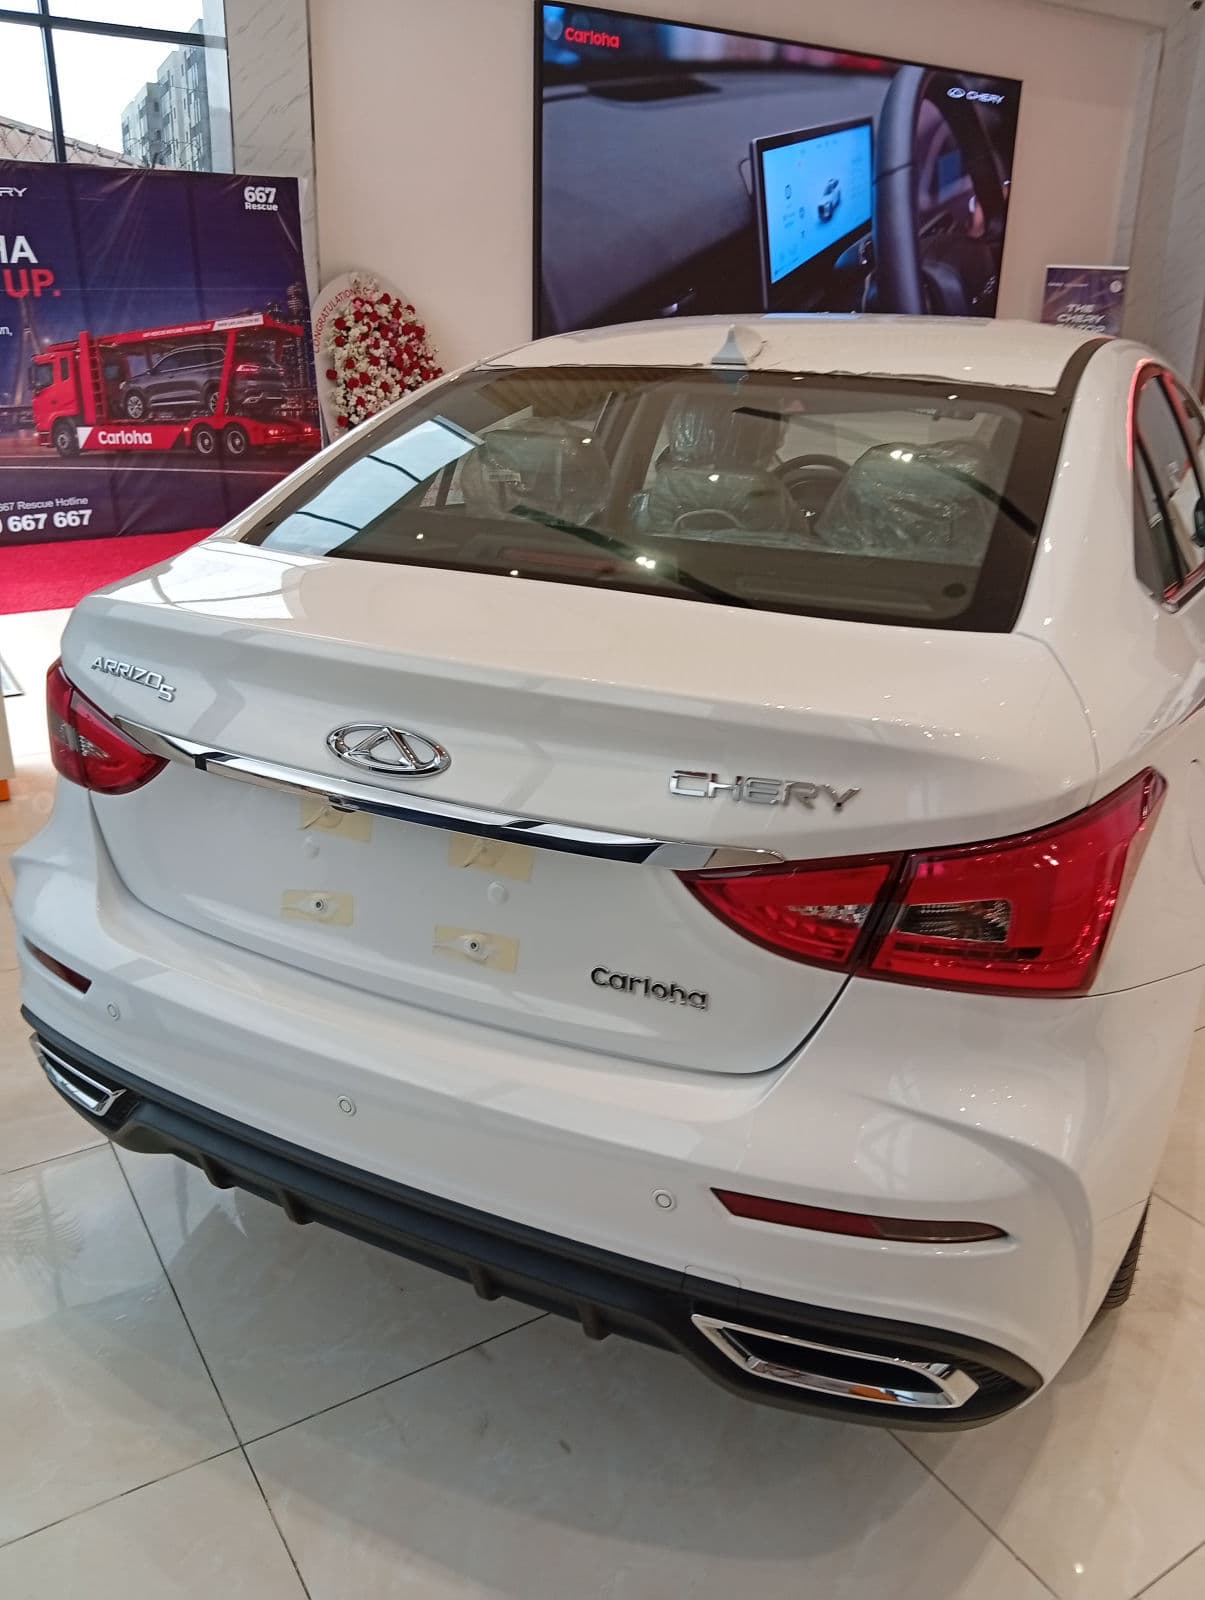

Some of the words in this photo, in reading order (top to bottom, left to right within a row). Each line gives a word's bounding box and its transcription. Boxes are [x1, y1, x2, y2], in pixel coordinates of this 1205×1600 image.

[564, 26, 621, 48] Carloha
[243, 186, 276, 203] 667
[244, 202, 278, 211] Rescue
[3, 268, 62, 298] UP.
[97, 428, 153, 446] Carloha
[17, 500, 54, 510] Rescue
[55, 497, 89, 507] Hotline
[7, 513, 48, 532] 667
[53, 509, 93, 528] 667
[669, 769, 863, 812] CHERY
[590, 965, 710, 1011] Carloha
